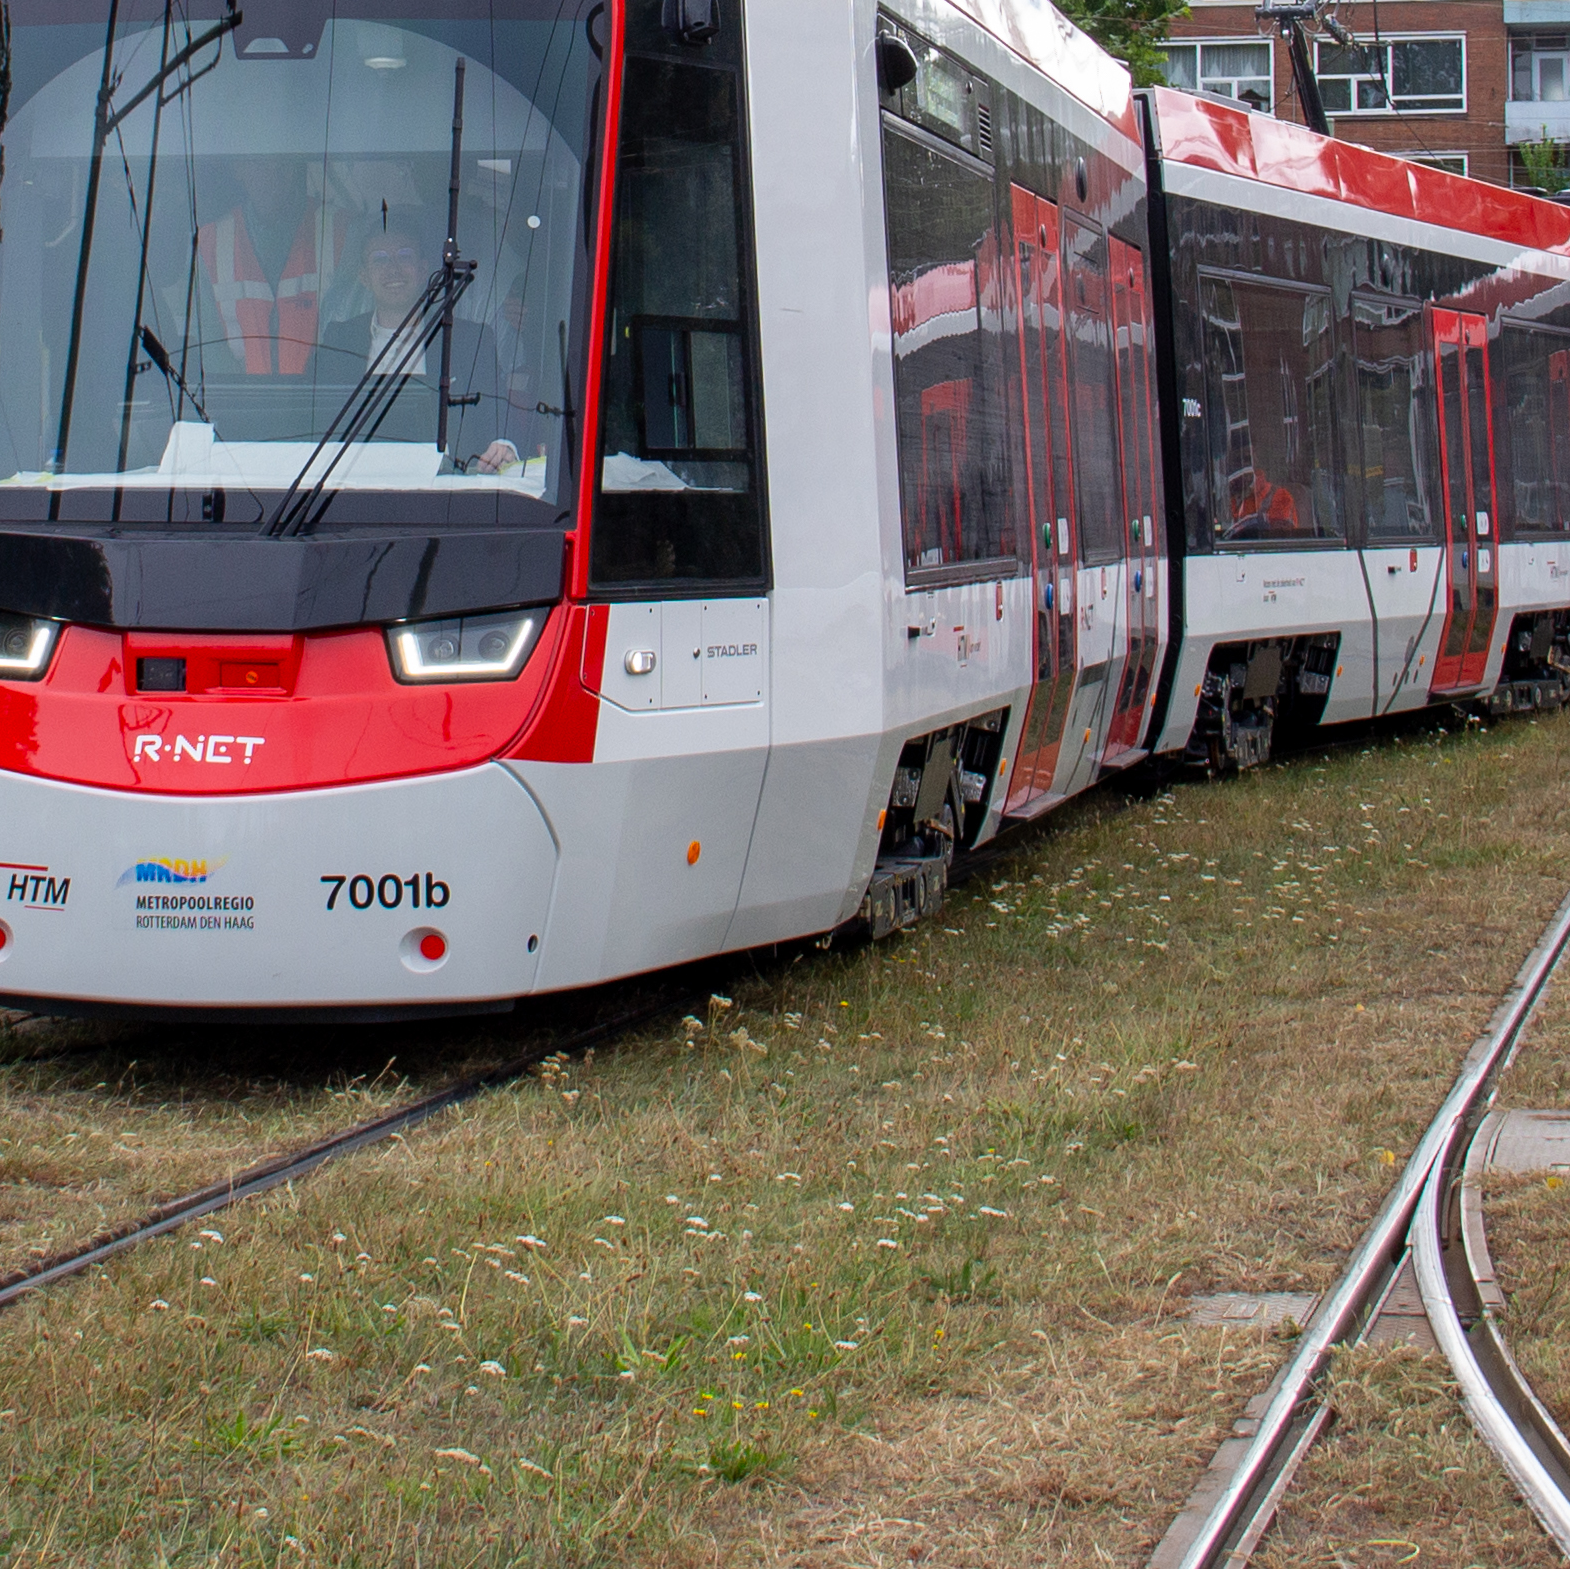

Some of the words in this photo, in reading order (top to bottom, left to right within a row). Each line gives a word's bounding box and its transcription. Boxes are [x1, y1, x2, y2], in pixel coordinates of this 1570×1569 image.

[706, 643, 758, 658] STADLER
[7, 873, 71, 905] HTM
[320, 871, 451, 911] 7001b
[135, 895, 255, 911] METROPOOLREGIO
[135, 914, 198, 930] ROTTERDAM
[199, 915, 221, 930] DEN
[223, 915, 255, 930] HAAG
